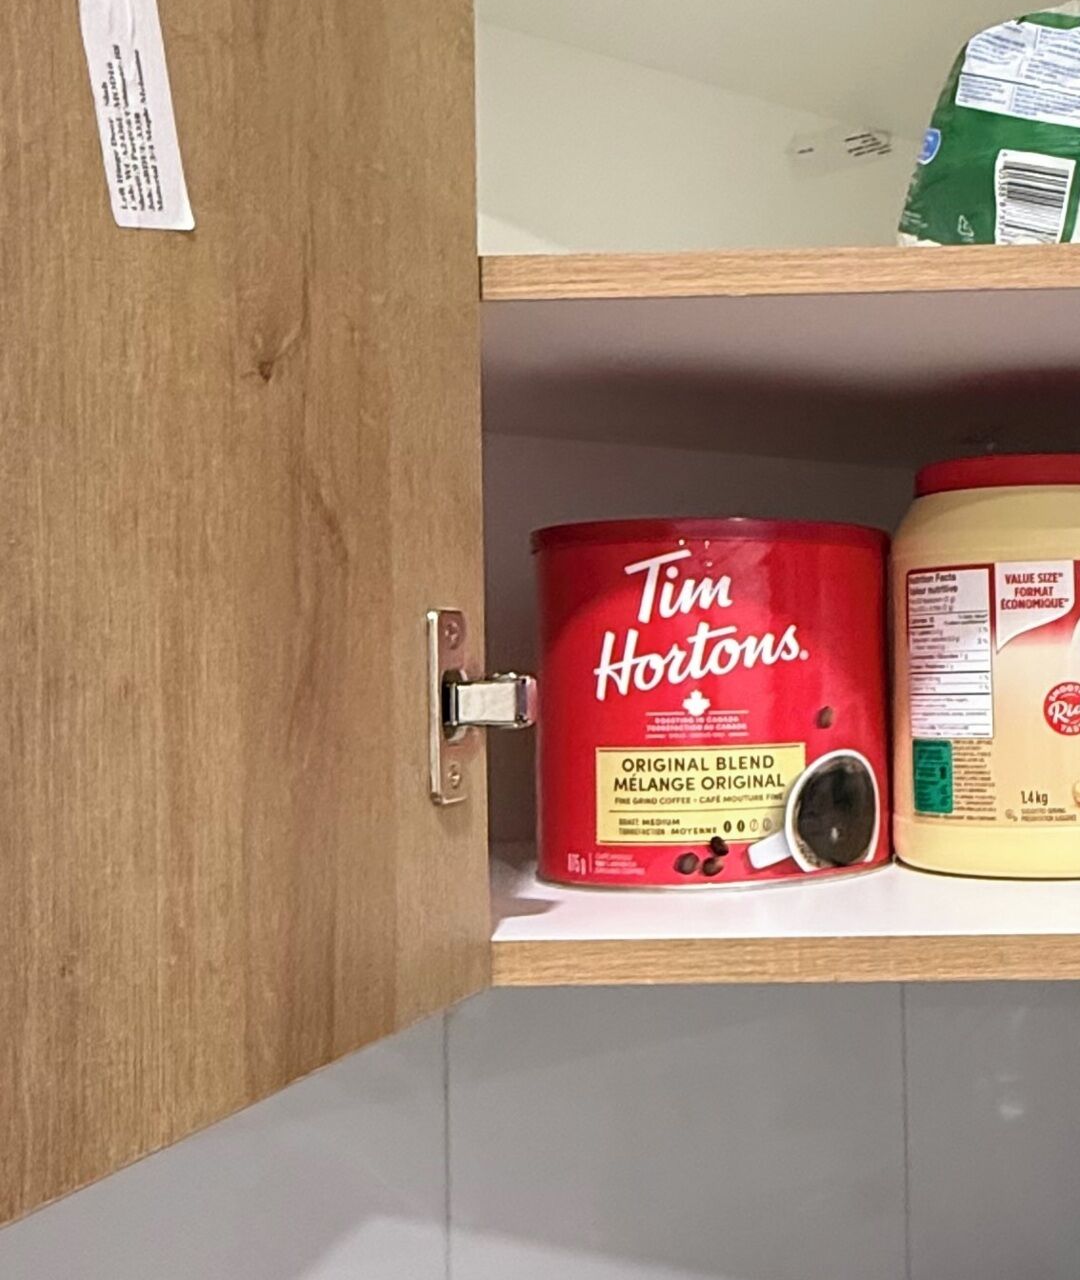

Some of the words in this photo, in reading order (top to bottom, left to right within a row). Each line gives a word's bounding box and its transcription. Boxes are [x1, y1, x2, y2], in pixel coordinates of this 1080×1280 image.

[625, 549, 732, 624] Tim
[1005, 573, 1036, 584] VALUE
[1014, 586, 1054, 597] FORMAT
[622, 757, 709, 772] ORIGINAL
[716, 755, 775, 770] BLEND
[613, 774, 696, 792] MÉLANGE
[701, 773, 786, 790] ORIGINAL
[1035, 791, 1049, 806] kg
